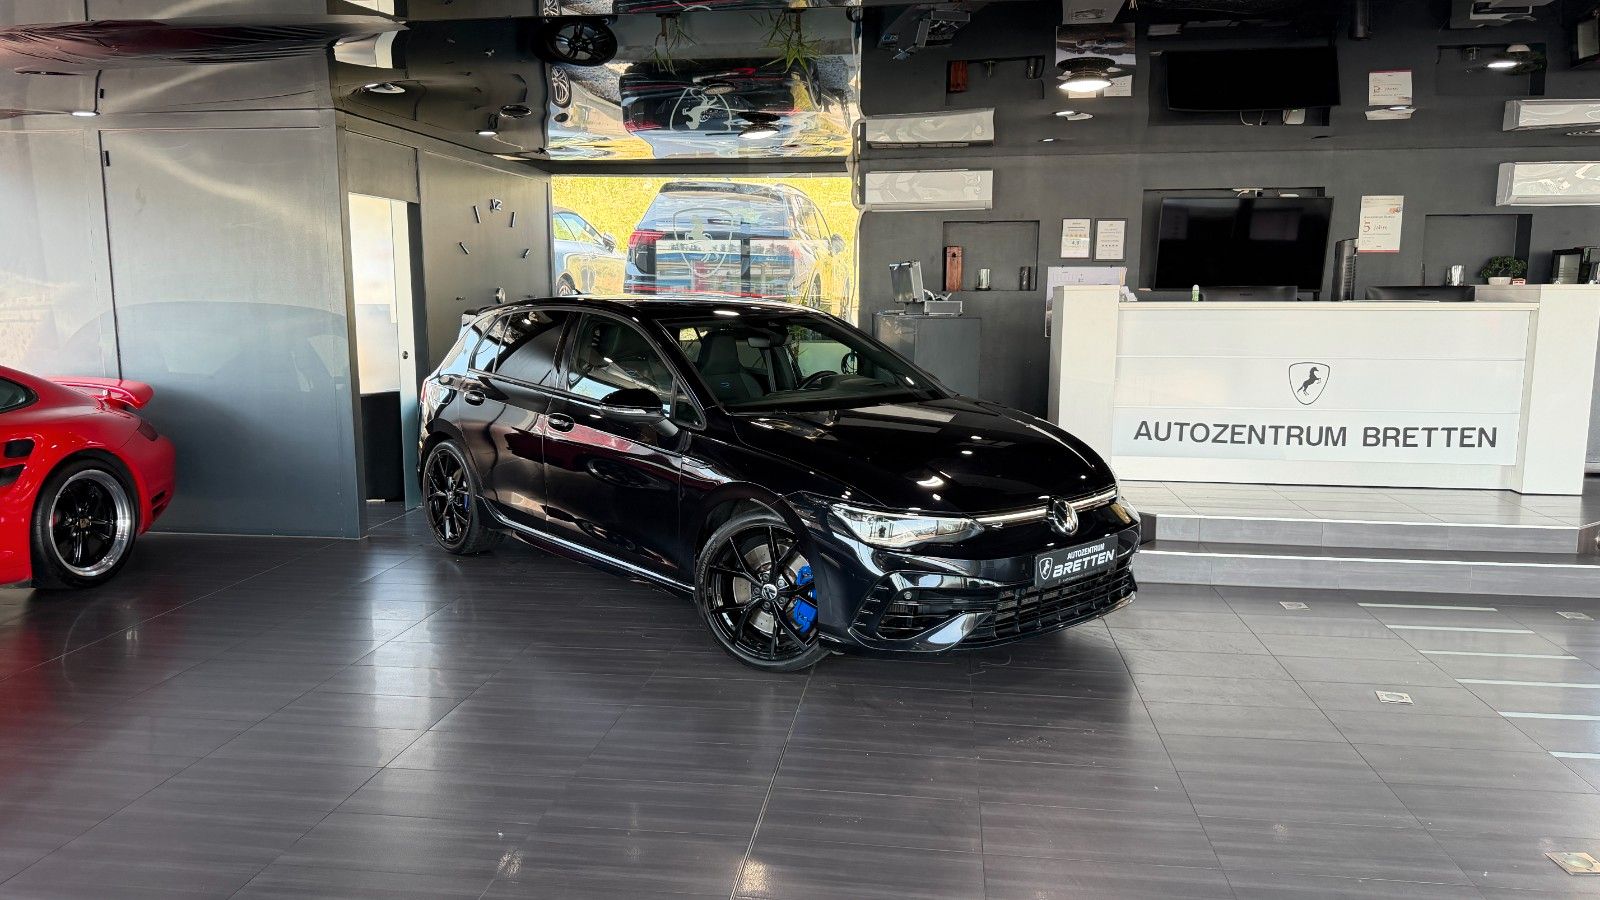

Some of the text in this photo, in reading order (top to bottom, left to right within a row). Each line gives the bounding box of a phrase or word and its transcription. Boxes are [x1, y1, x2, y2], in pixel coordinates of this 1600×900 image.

[1363, 220, 1371, 233] 5
[1133, 420, 1498, 448] AUTOZENTRUM BRETTEN
[1067, 543, 1105, 560] AUTOZENTRUM
[1052, 549, 1115, 578] BRETTEN
